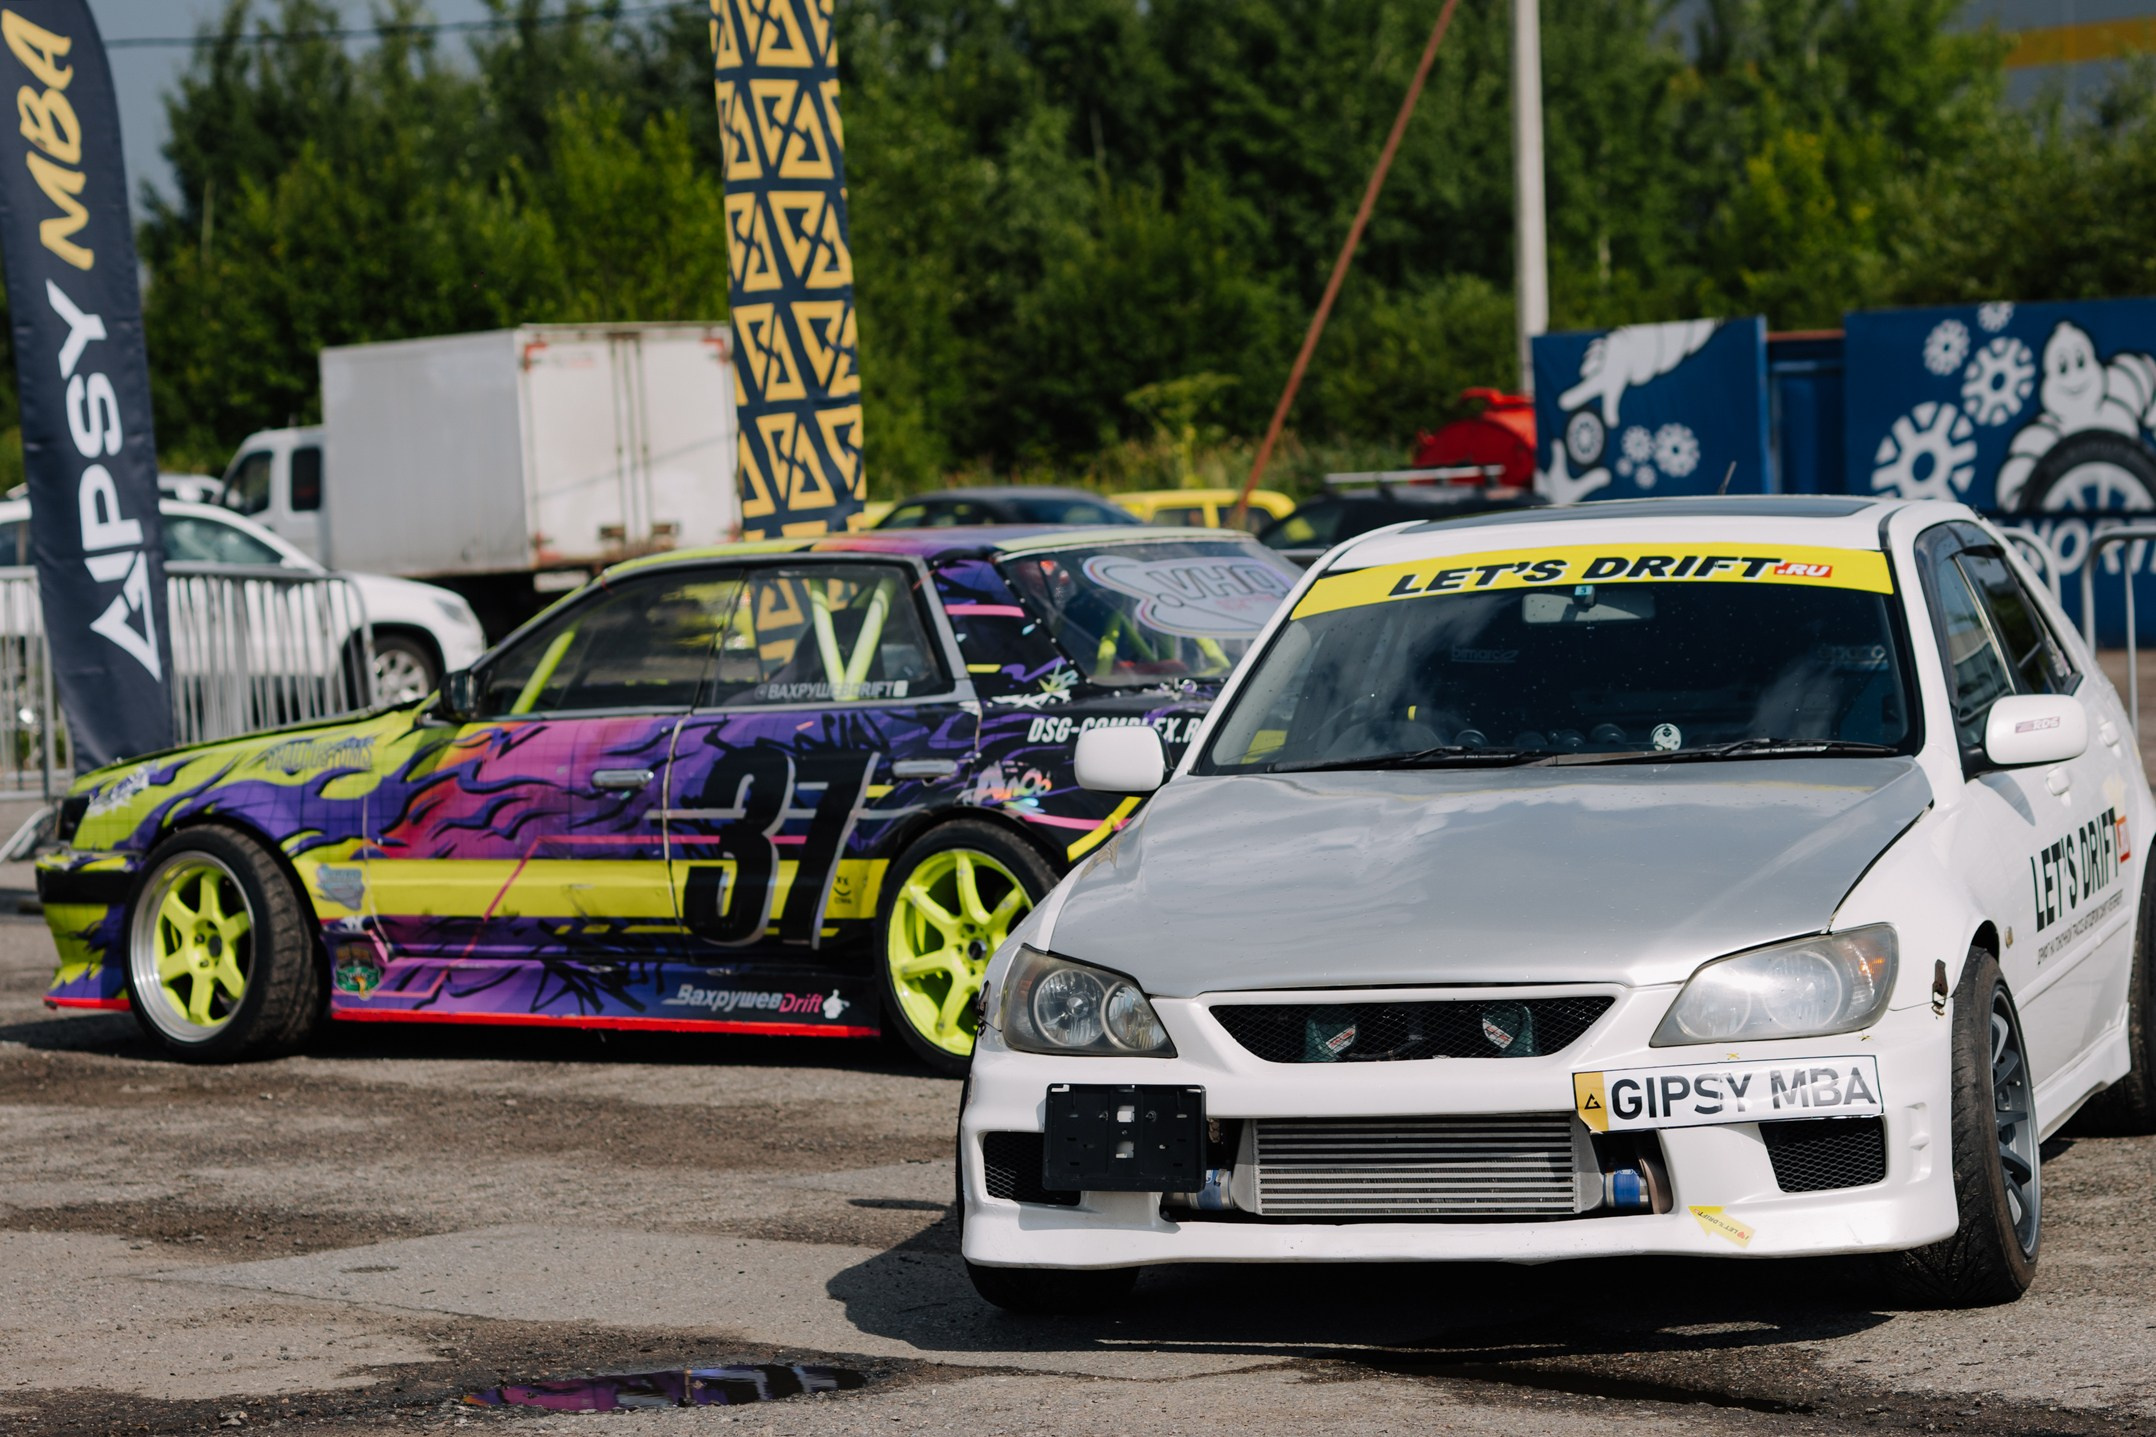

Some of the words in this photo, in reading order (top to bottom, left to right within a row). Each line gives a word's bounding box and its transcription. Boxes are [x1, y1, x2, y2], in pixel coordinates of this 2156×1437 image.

[1, 8, 95, 271] MBA
[1388, 557, 1568, 598] LET'S
[2012, 517, 2156, 575] NORT
[680, 748, 881, 951] 37
[2030, 833, 2078, 932] LET'S
[1611, 1072, 1752, 1120] GIPSY
[1769, 1066, 1876, 1109] MBA
